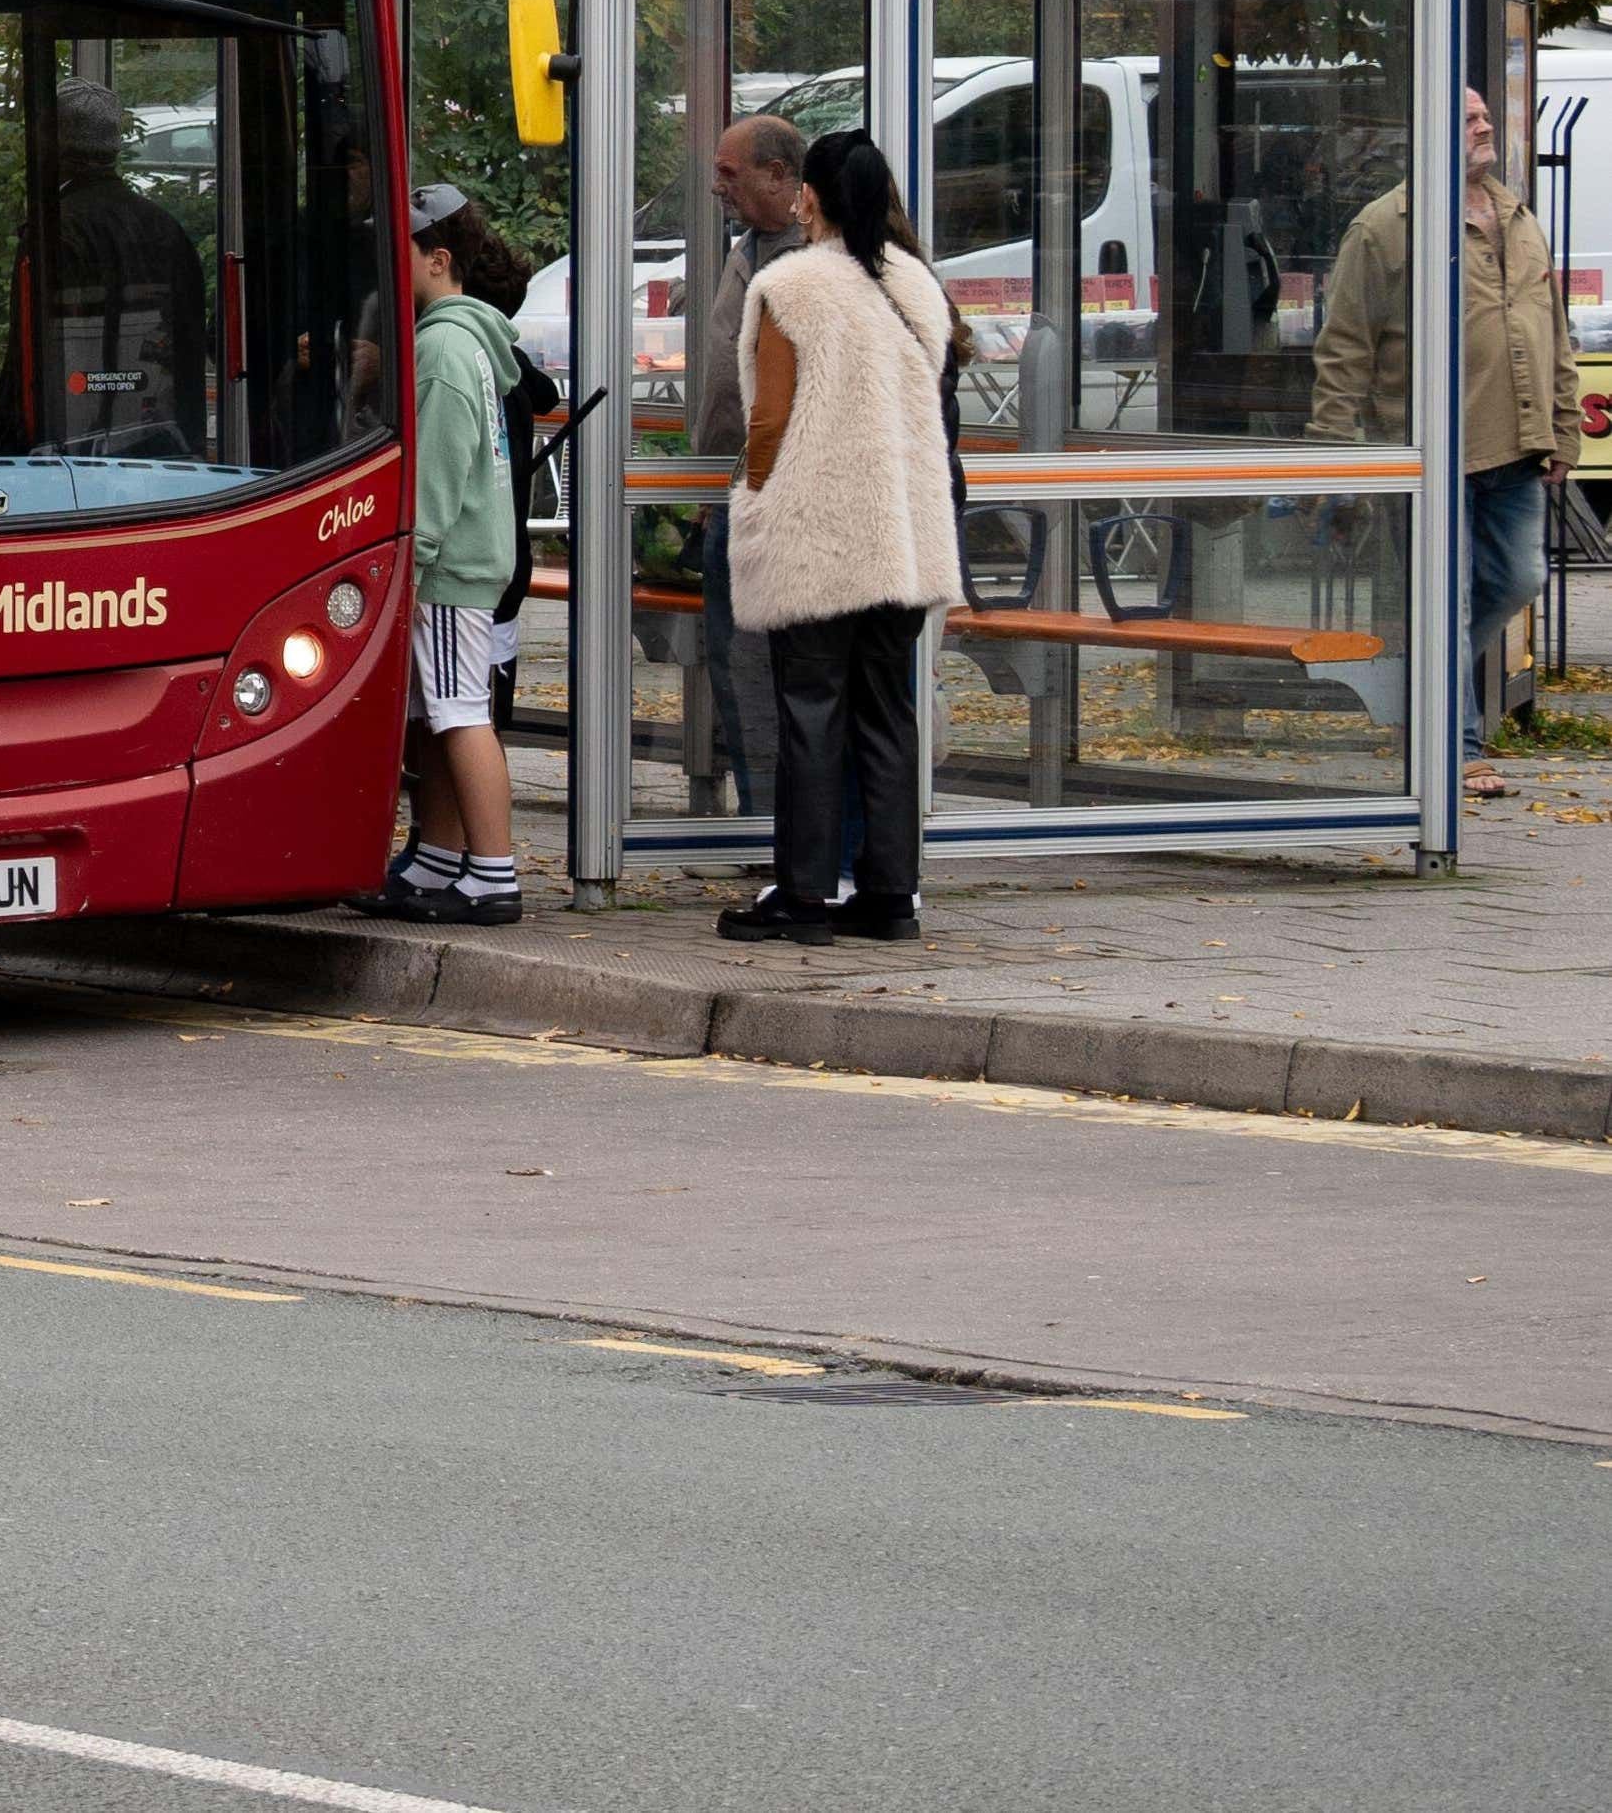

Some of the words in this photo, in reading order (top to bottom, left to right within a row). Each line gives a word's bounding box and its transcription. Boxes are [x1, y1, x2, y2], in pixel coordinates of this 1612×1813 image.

[87, 383, 106, 391] PUSH
[107, 382, 116, 391] TO
[116, 382, 136, 391] OPEN
[317, 493, 376, 542] Chloe
